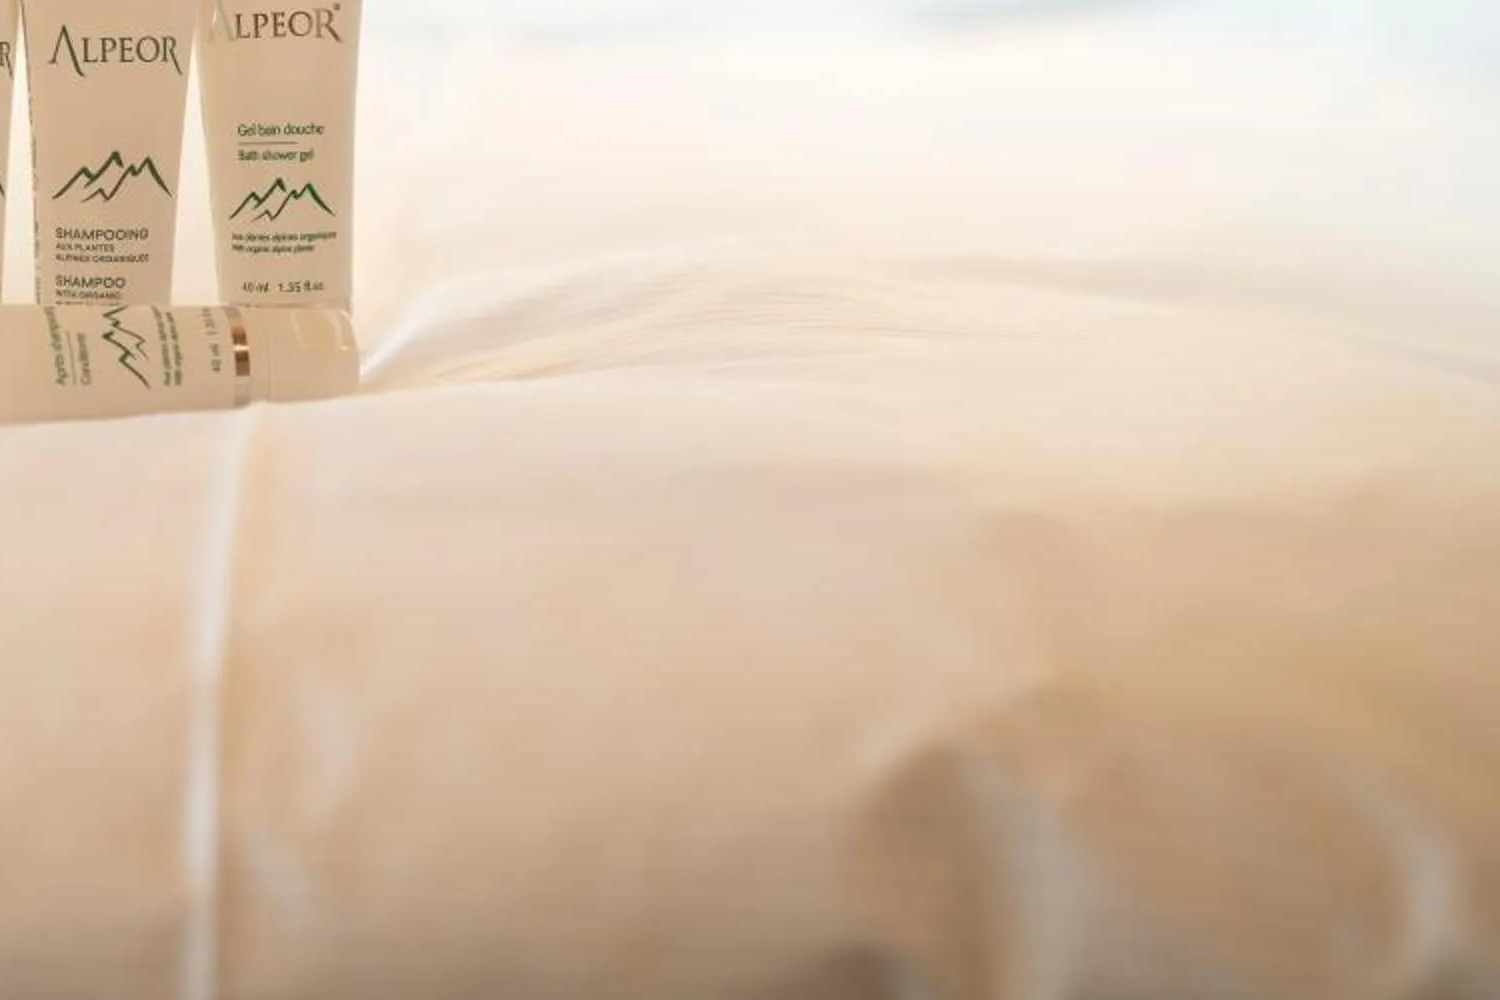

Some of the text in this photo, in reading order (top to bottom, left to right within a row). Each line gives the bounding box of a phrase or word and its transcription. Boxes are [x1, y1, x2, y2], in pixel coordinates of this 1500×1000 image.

[48, 23, 183, 76] ALPEOR
[237, 121, 325, 137] Gel bain douche
[262, 149, 297, 161] shower
[299, 148, 315, 163] gel
[55, 226, 149, 241] SHAMPOOING
[55, 275, 126, 289] SHAMPOO
